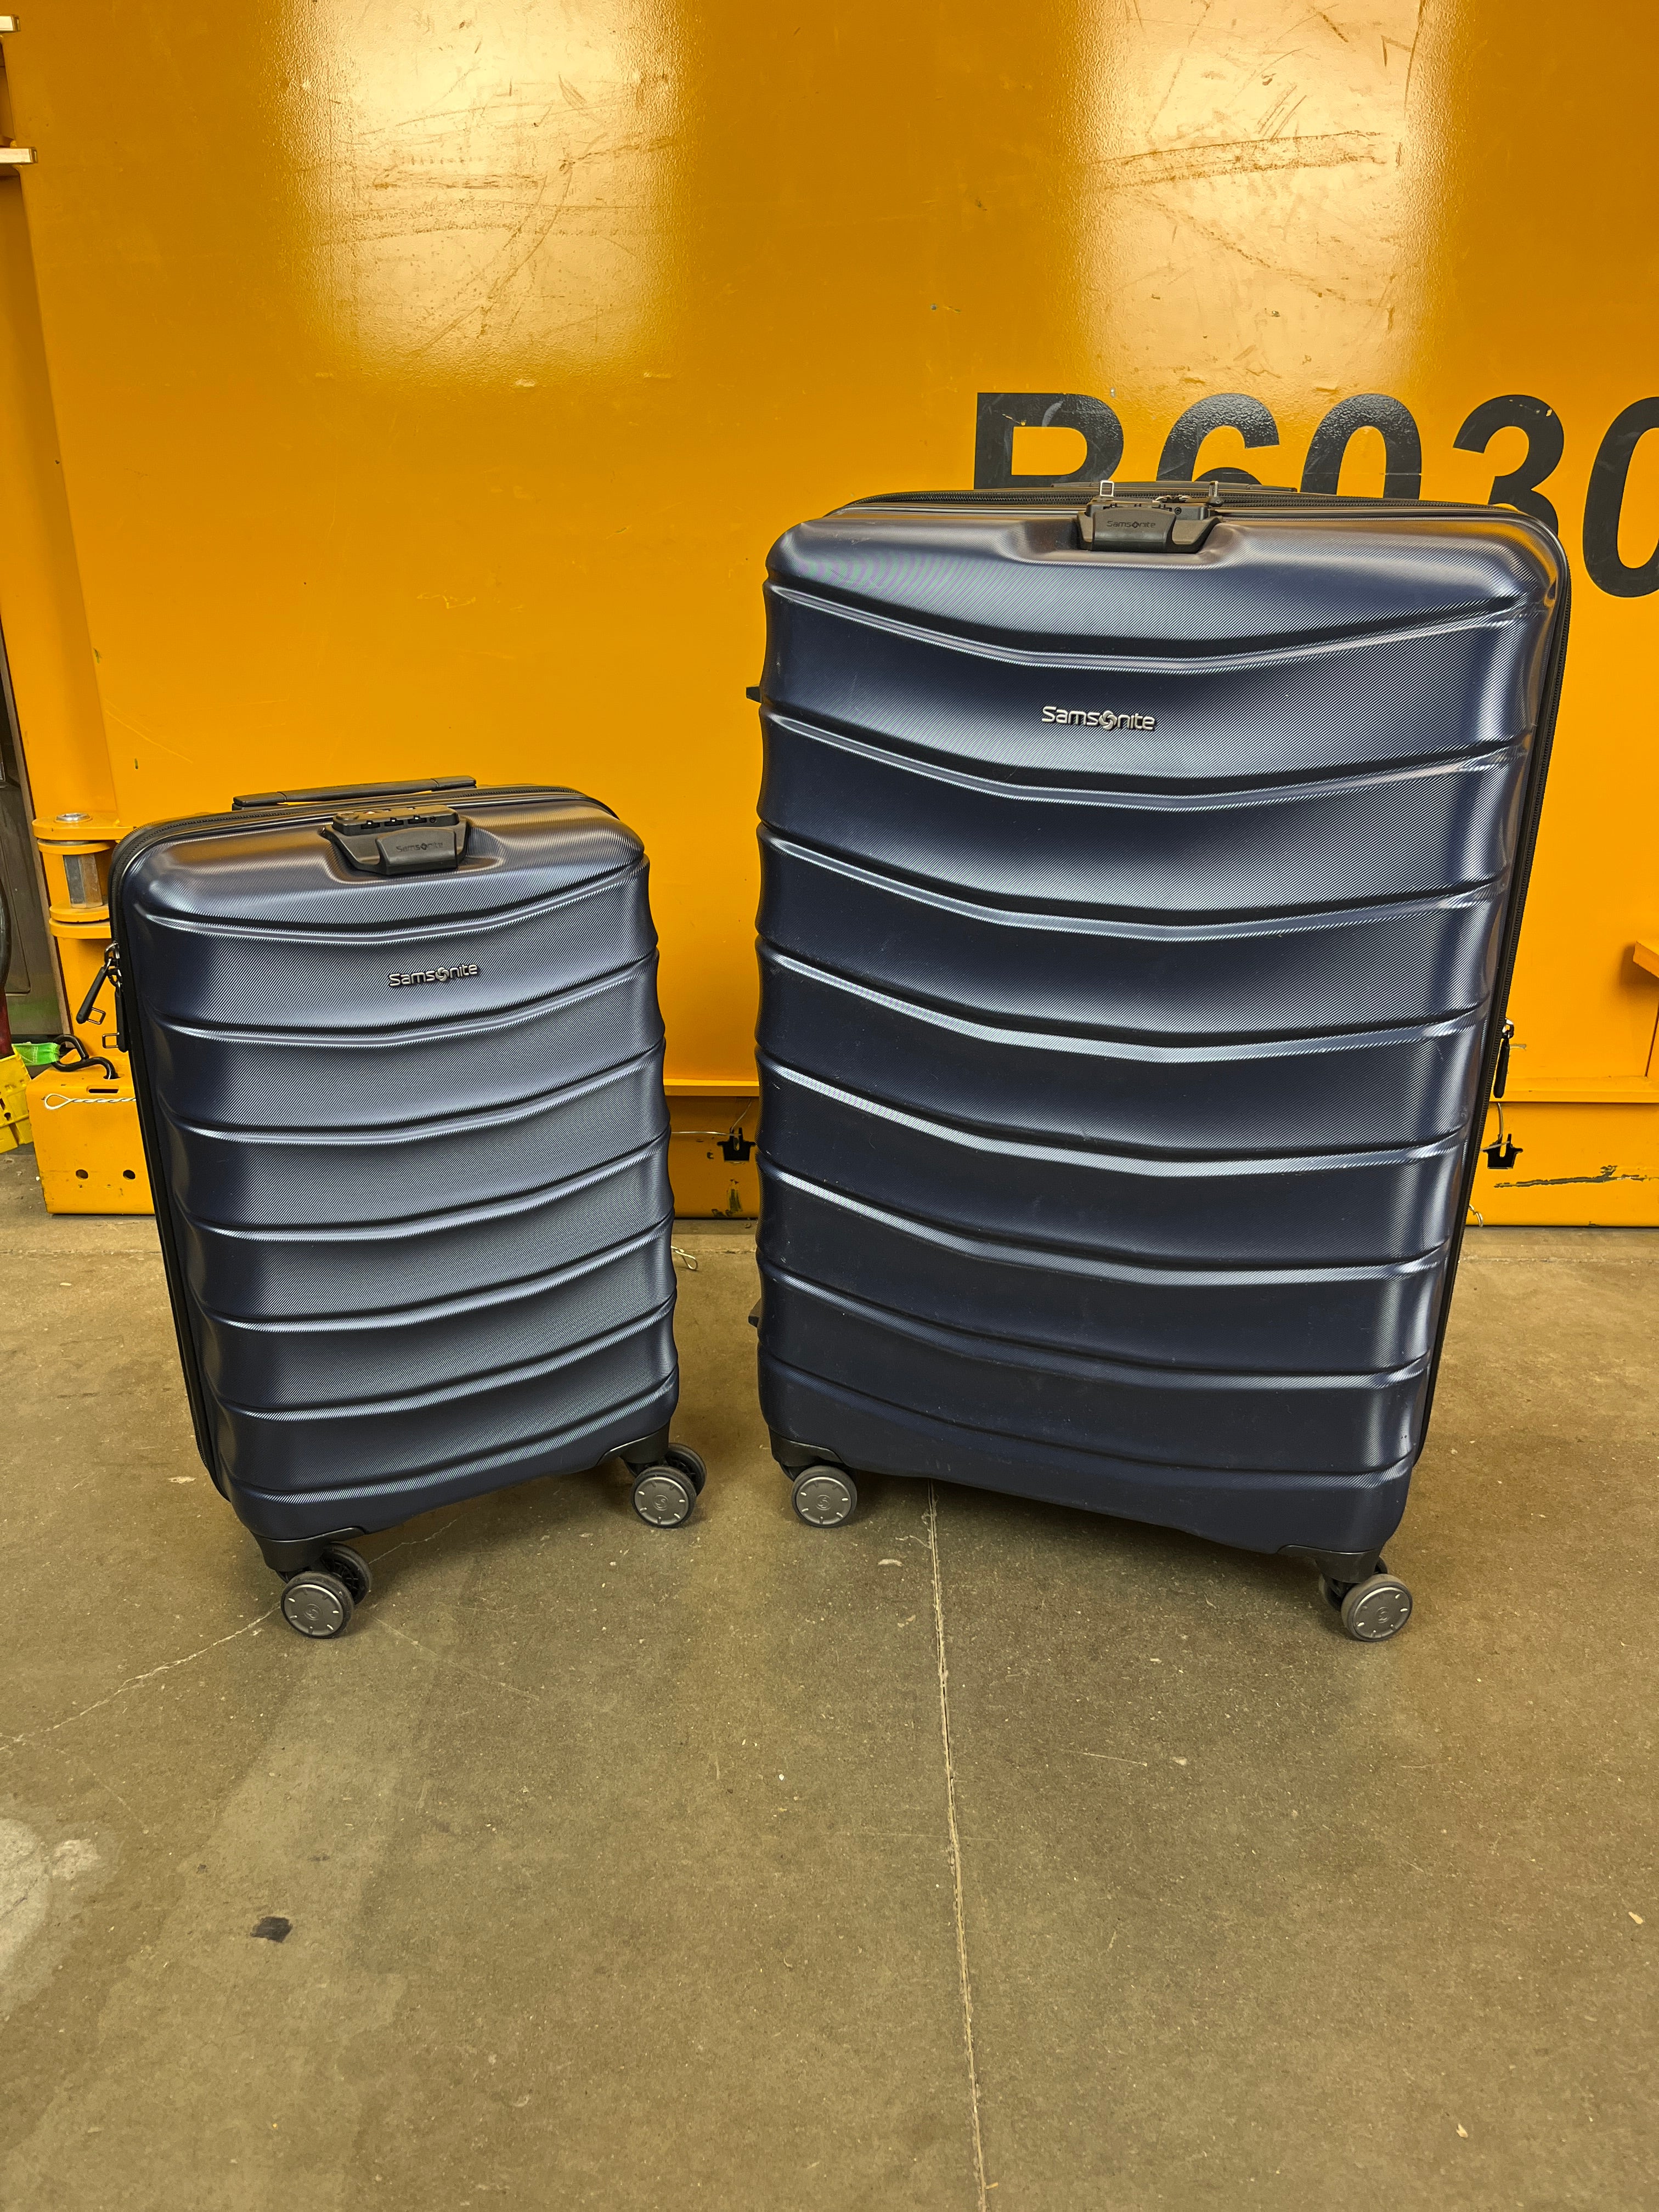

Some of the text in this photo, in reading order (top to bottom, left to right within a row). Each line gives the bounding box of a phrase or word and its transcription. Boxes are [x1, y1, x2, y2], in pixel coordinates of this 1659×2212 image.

[1106, 521, 1156, 529] Samsonite
[1041, 706, 1155, 731] Samsonite
[388, 964, 478, 986] Samsonite
